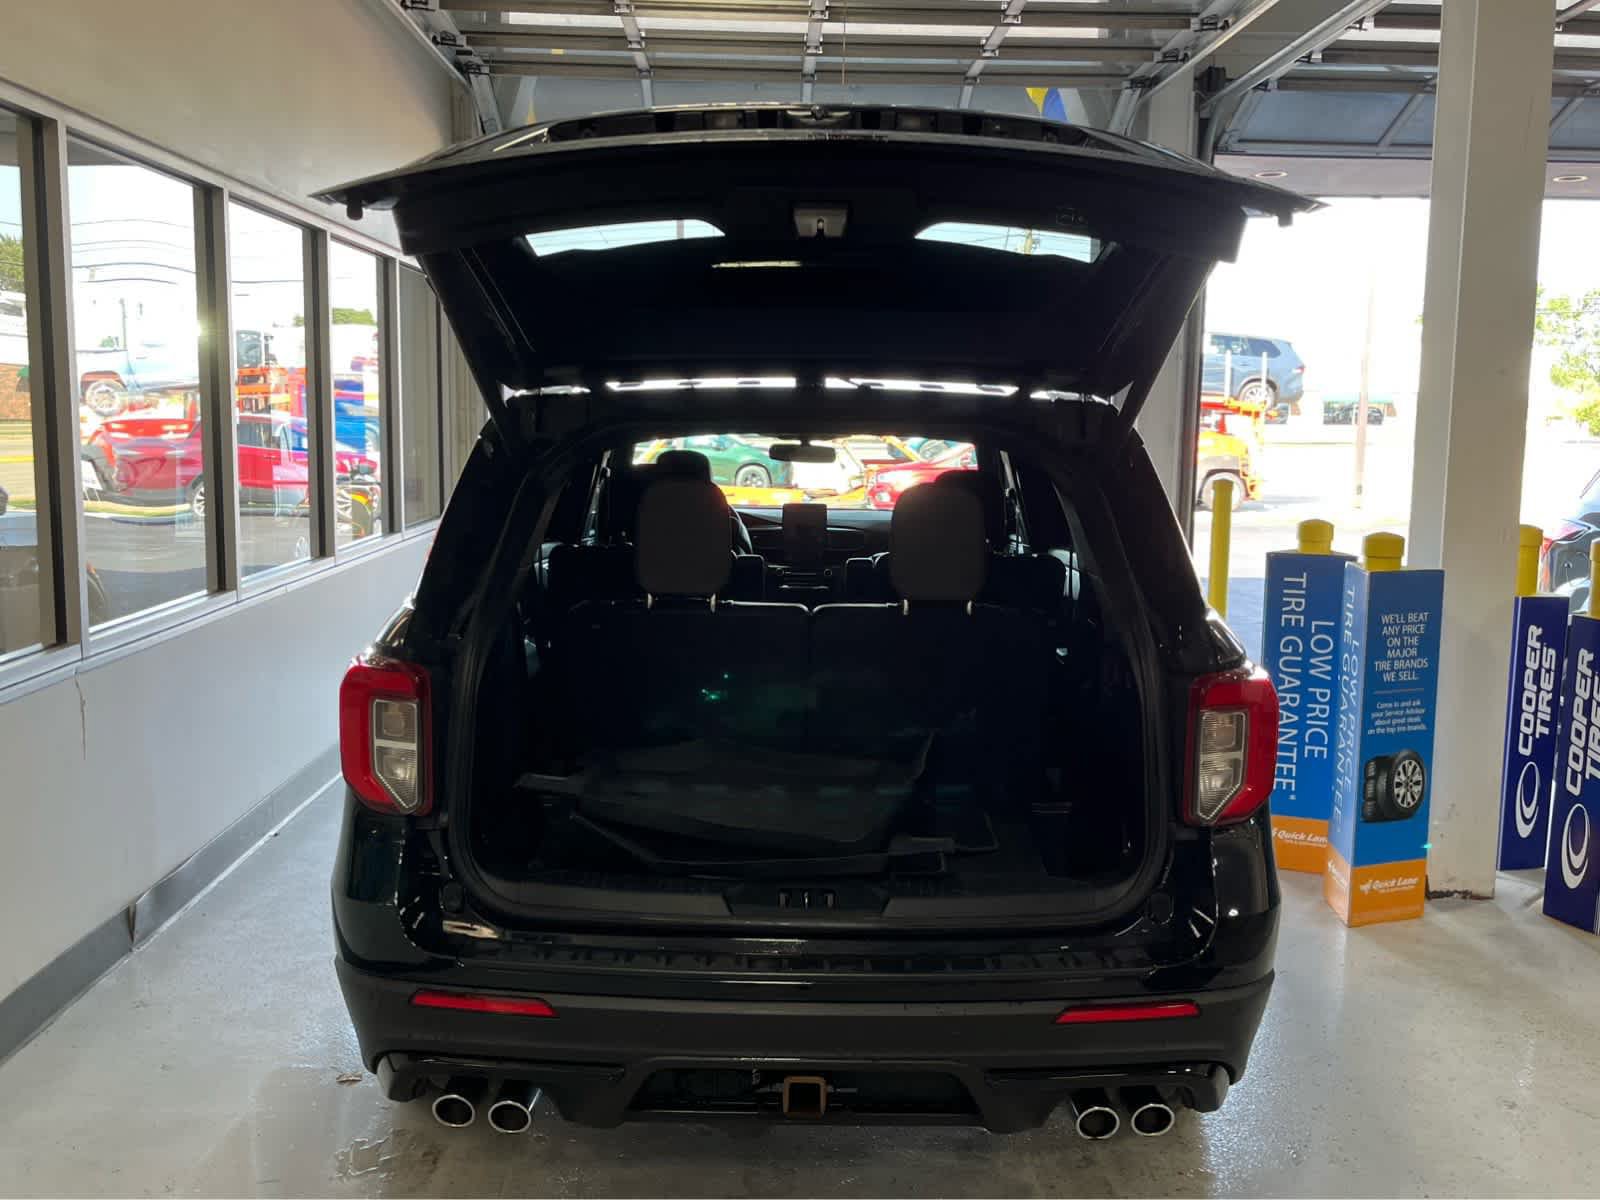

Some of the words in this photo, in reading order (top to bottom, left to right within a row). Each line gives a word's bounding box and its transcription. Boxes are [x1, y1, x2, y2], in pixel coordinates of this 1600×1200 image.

[1281, 572, 1307, 627] TIRE
[1343, 585, 1355, 646] TIRE
[1381, 613, 1406, 625] WE'LL
[1408, 612, 1429, 623] BEAT
[1308, 620, 1335, 680] LOW
[1382, 625, 1402, 636] ANY
[1402, 624, 1425, 634] PRICE
[1387, 637, 1400, 648] ON
[1402, 636, 1419, 646] THE
[1387, 647, 1417, 659] MAJOR
[1348, 639, 1359, 706] LOW
[1375, 660, 1391, 671] TIRE
[1393, 658, 1429, 670] BRANDS
[1383, 672, 1396, 683] WE
[1518, 624, 1543, 757] COOPER
[1535, 645, 1556, 739] TIRES
[1304, 687, 1331, 759] PRICE
[1566, 648, 1594, 797] COOPER
[1344, 713, 1356, 793] PRICE
[1277, 829, 1306, 841] Quick
[1307, 833, 1328, 844] Lan
[1373, 878, 1396, 890] Quick
[1396, 876, 1419, 887] Lane
